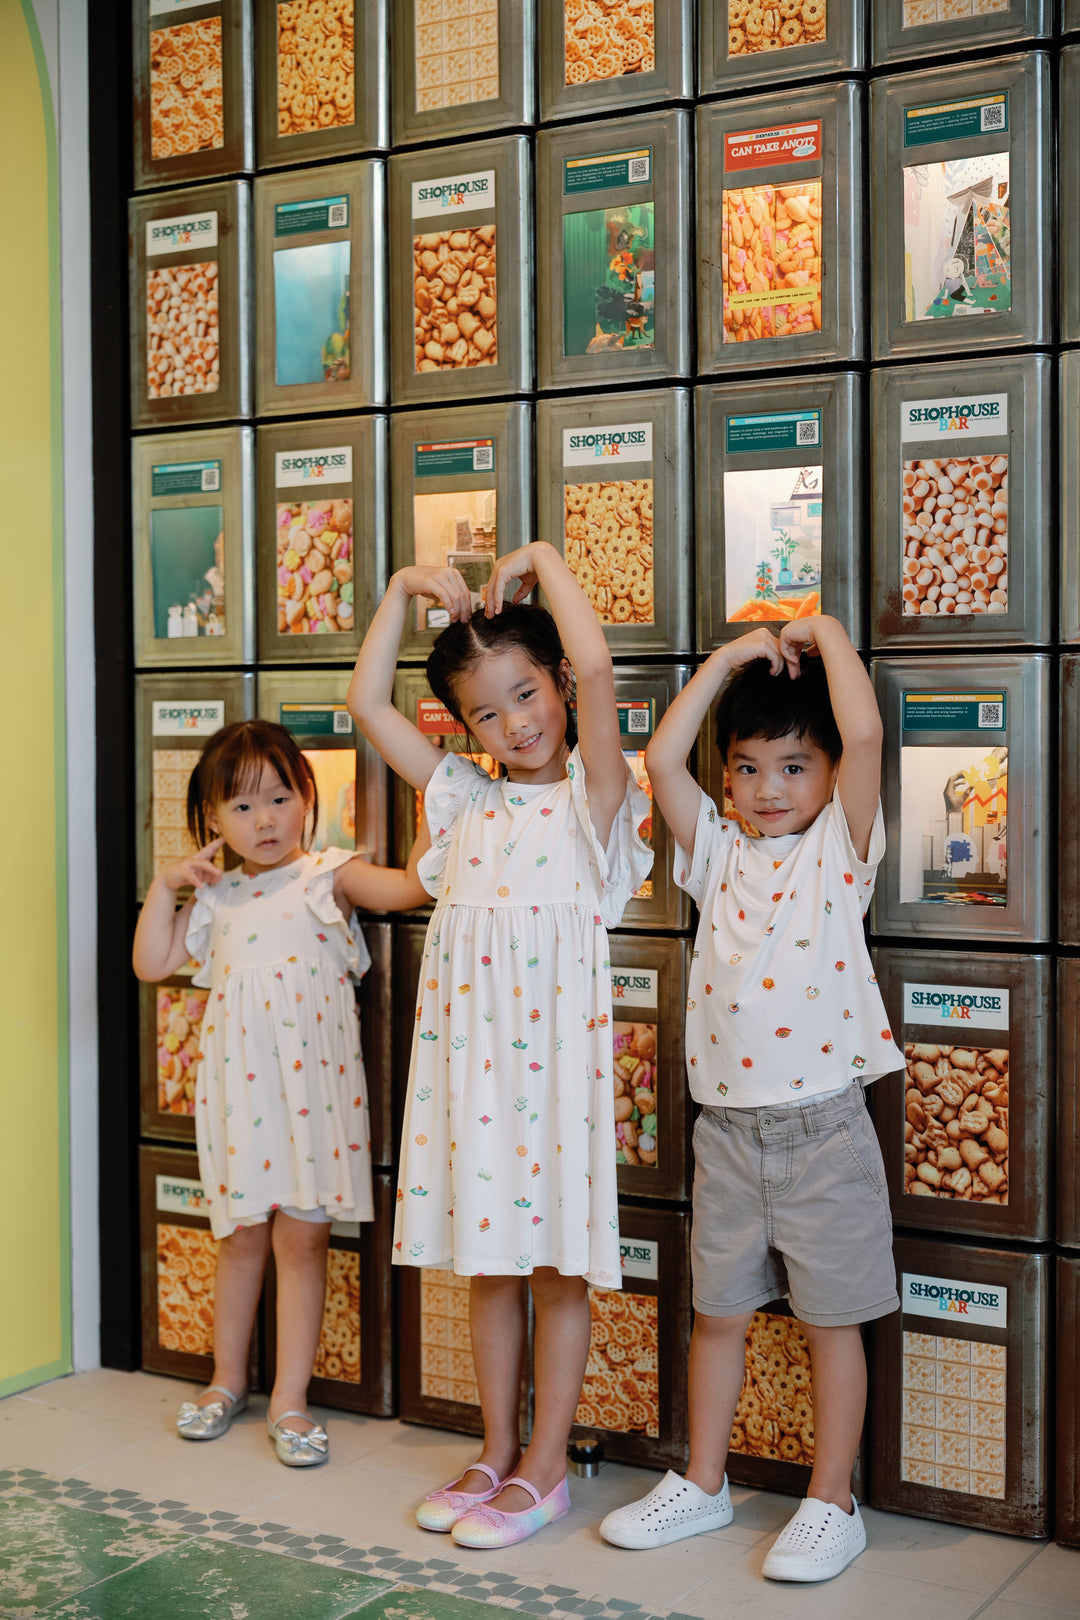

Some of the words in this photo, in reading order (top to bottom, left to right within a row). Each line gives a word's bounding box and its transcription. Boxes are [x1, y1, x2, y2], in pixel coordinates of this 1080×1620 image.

[731, 146, 752, 157] CAN
[753, 142, 780, 154] TAKE
[781, 136, 815, 150] ANOT?
[418, 179, 488, 200] SHOPHOUSE
[441, 192, 465, 207] BAR
[152, 219, 212, 239] SHOPHOUSE
[171, 231, 192, 245] BAR
[909, 402, 1000, 422] SHOPHOUSE
[938, 416, 969, 431] BAR
[569, 430, 646, 448] SHOPHOUSE
[594, 443, 620, 457] BAR
[282, 454, 346, 470] SHOPHOUSE
[303, 465, 325, 478] BAR
[159, 708, 218, 720] SHOPHOUSE
[423, 713, 442, 722] CAN
[178, 716, 199, 729] BAR
[611, 975, 651, 989] HOUSE
[911, 991, 1001, 1010] SHOPHOUSE
[941, 1004, 971, 1019] BAR
[163, 1184, 204, 1198] SHOPHO
[181, 1194, 201, 1208] BAR
[909, 1282, 999, 1307] SHOPHOUSE
[938, 1297, 969, 1315] BAR
